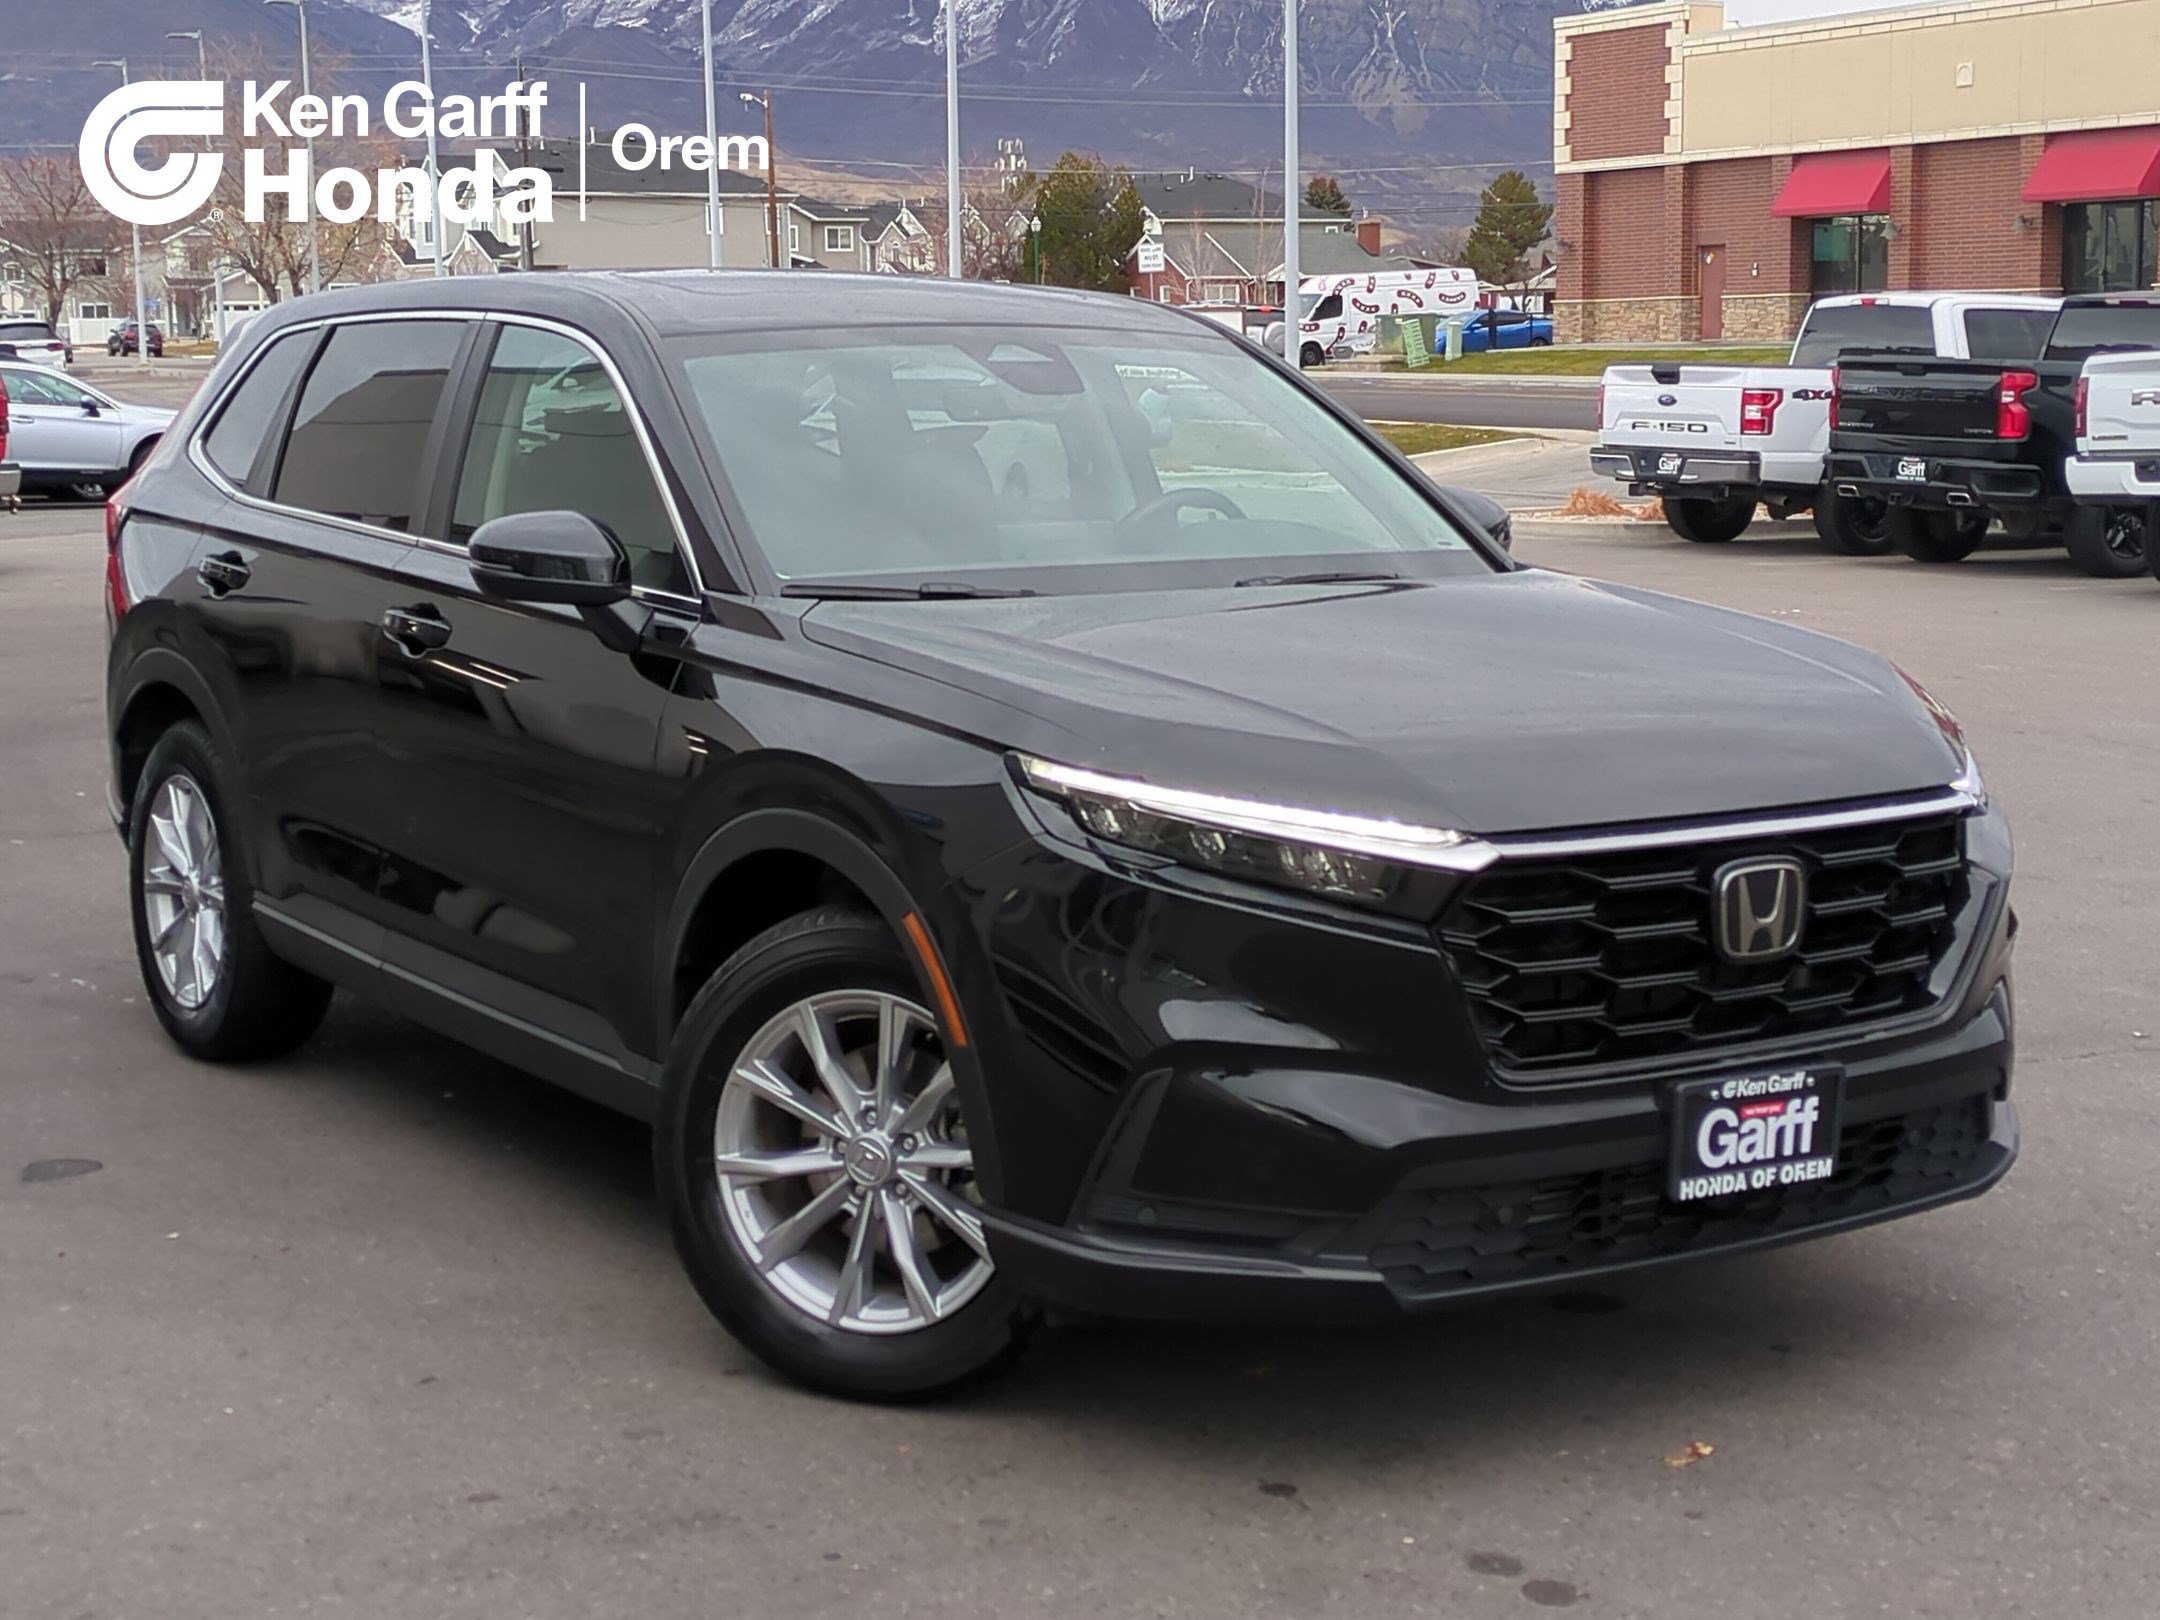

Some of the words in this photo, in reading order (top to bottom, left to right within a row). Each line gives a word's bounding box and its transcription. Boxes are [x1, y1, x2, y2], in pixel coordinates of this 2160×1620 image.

[1631, 421, 1708, 433] F-150
[1736, 1079, 1767, 1098] Ken
[1768, 1071, 1807, 1093] Garff
[1697, 1096, 1820, 1169] Garff
[1679, 1172, 1748, 1201] HONDA
[1751, 1167, 1777, 1188] OF
[1780, 1157, 1833, 1184] OREM
